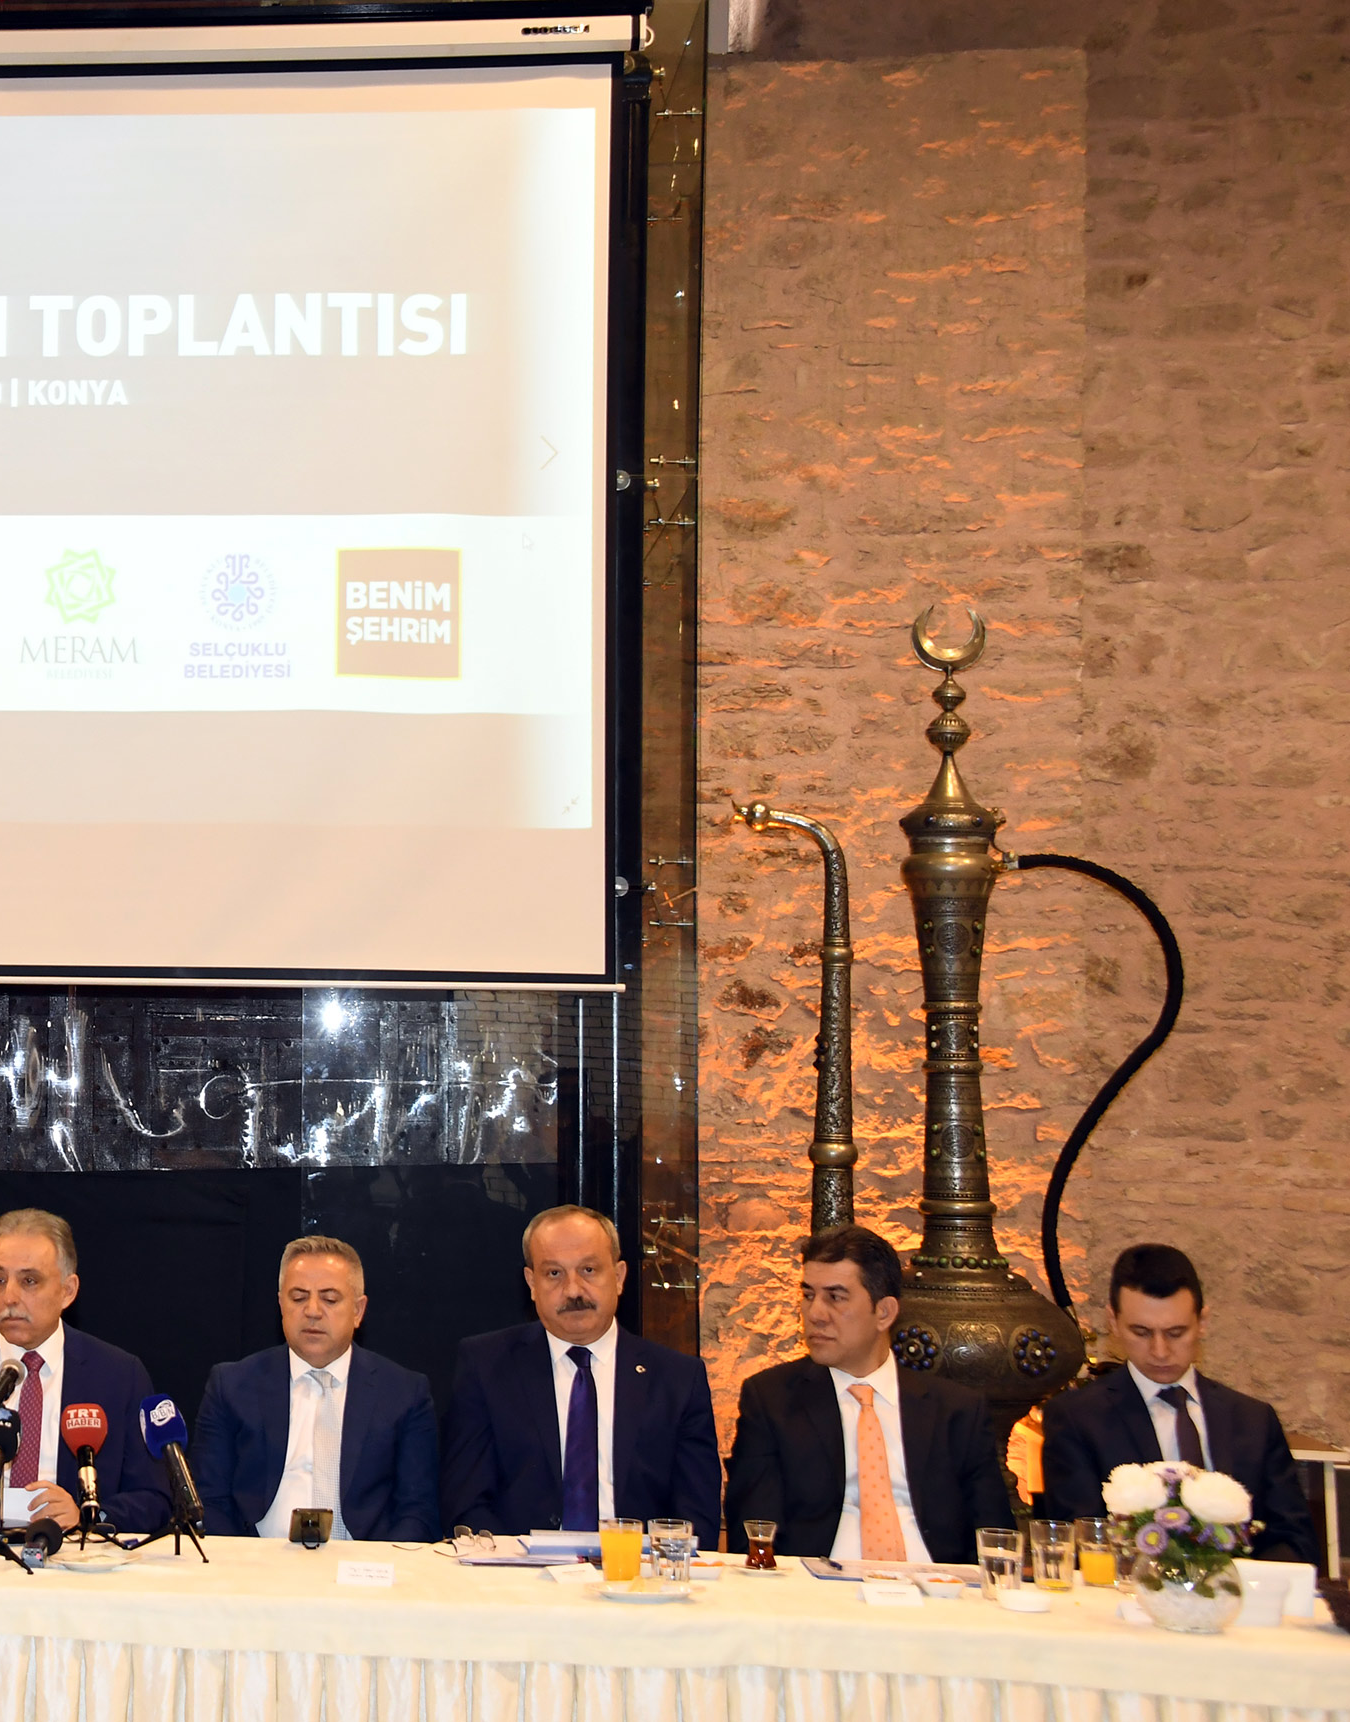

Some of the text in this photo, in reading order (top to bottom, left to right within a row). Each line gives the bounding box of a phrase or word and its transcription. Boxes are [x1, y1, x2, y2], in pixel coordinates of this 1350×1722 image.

[30, 292, 469, 358] TOPLANTISI
[27, 379, 130, 407] KONYA
[20, 636, 140, 664] MERAM
[189, 642, 287, 661] SELÇUKLU
[184, 660, 291, 679] BELEDİYESİ
[67, 1408, 99, 1419] TRT
[67, 1418, 100, 1429] HABER
